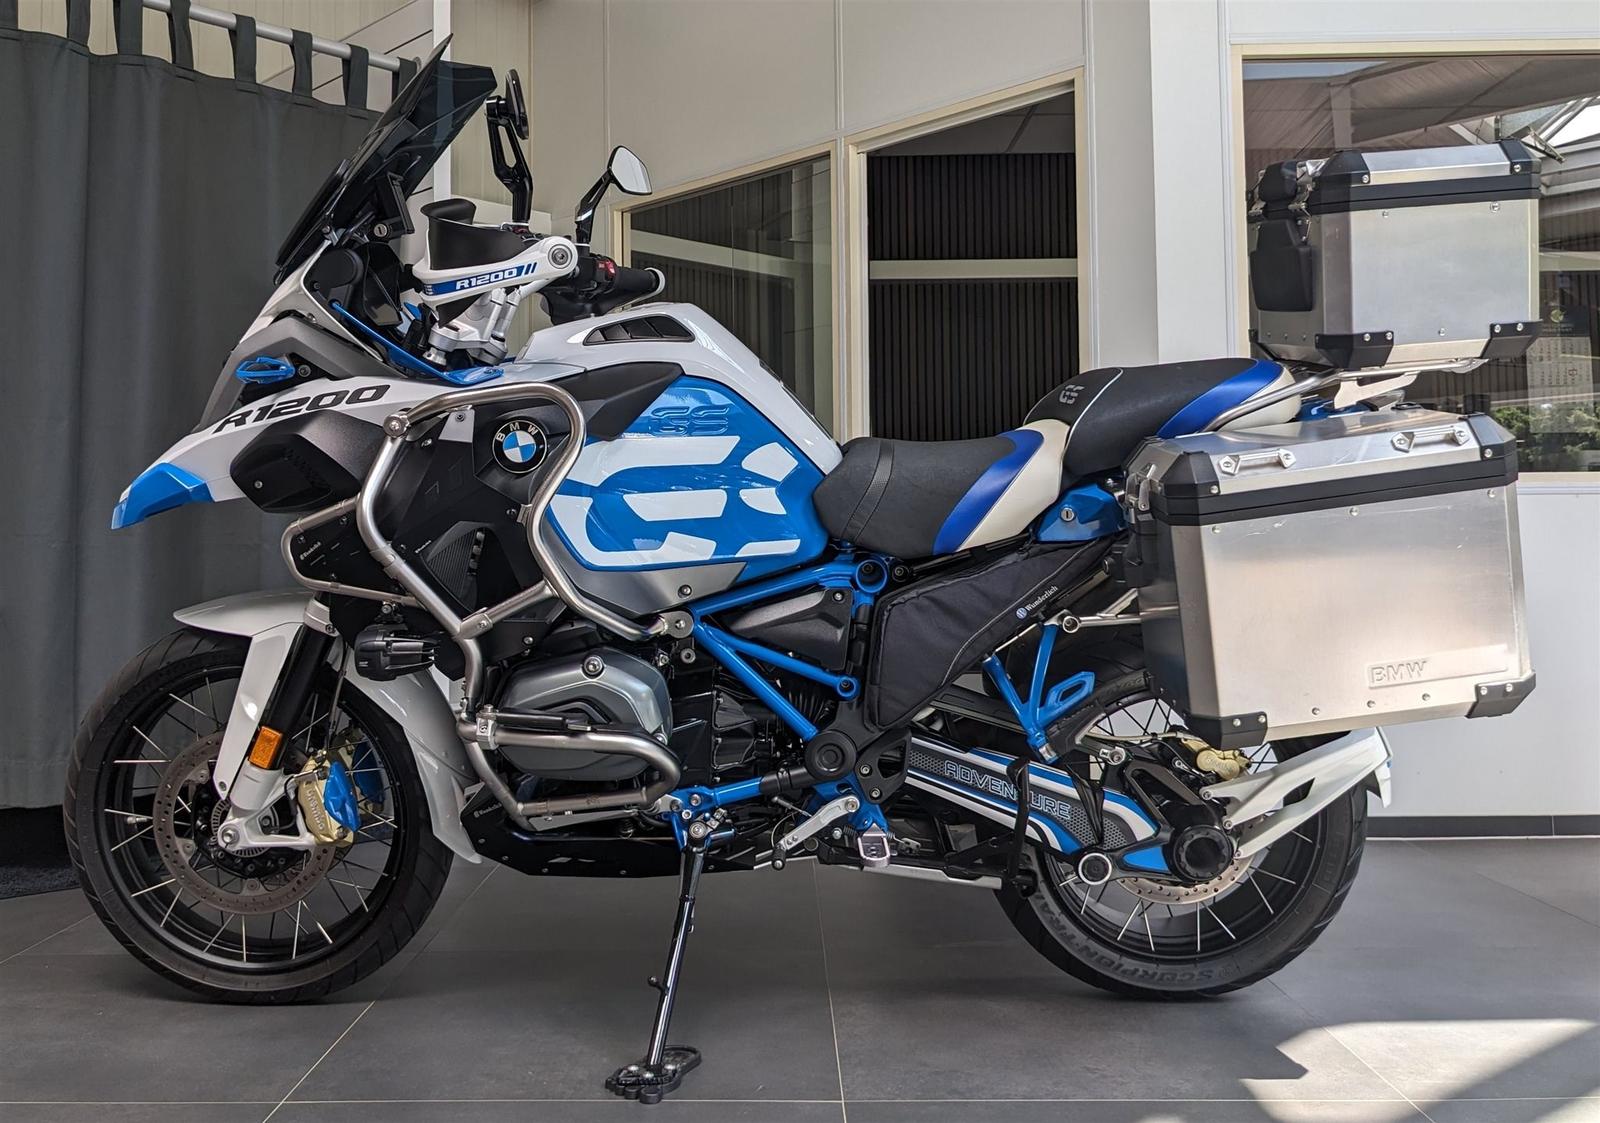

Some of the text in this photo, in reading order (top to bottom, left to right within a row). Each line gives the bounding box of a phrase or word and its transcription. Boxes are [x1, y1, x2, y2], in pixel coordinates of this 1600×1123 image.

[456, 267, 518, 290] R1200
[212, 384, 391, 434] R1200
[495, 421, 539, 442] BMW
[1024, 585, 1059, 612] Wunderlich
[1370, 660, 1427, 684] BMW
[944, 760, 1071, 820] ADVENURE
